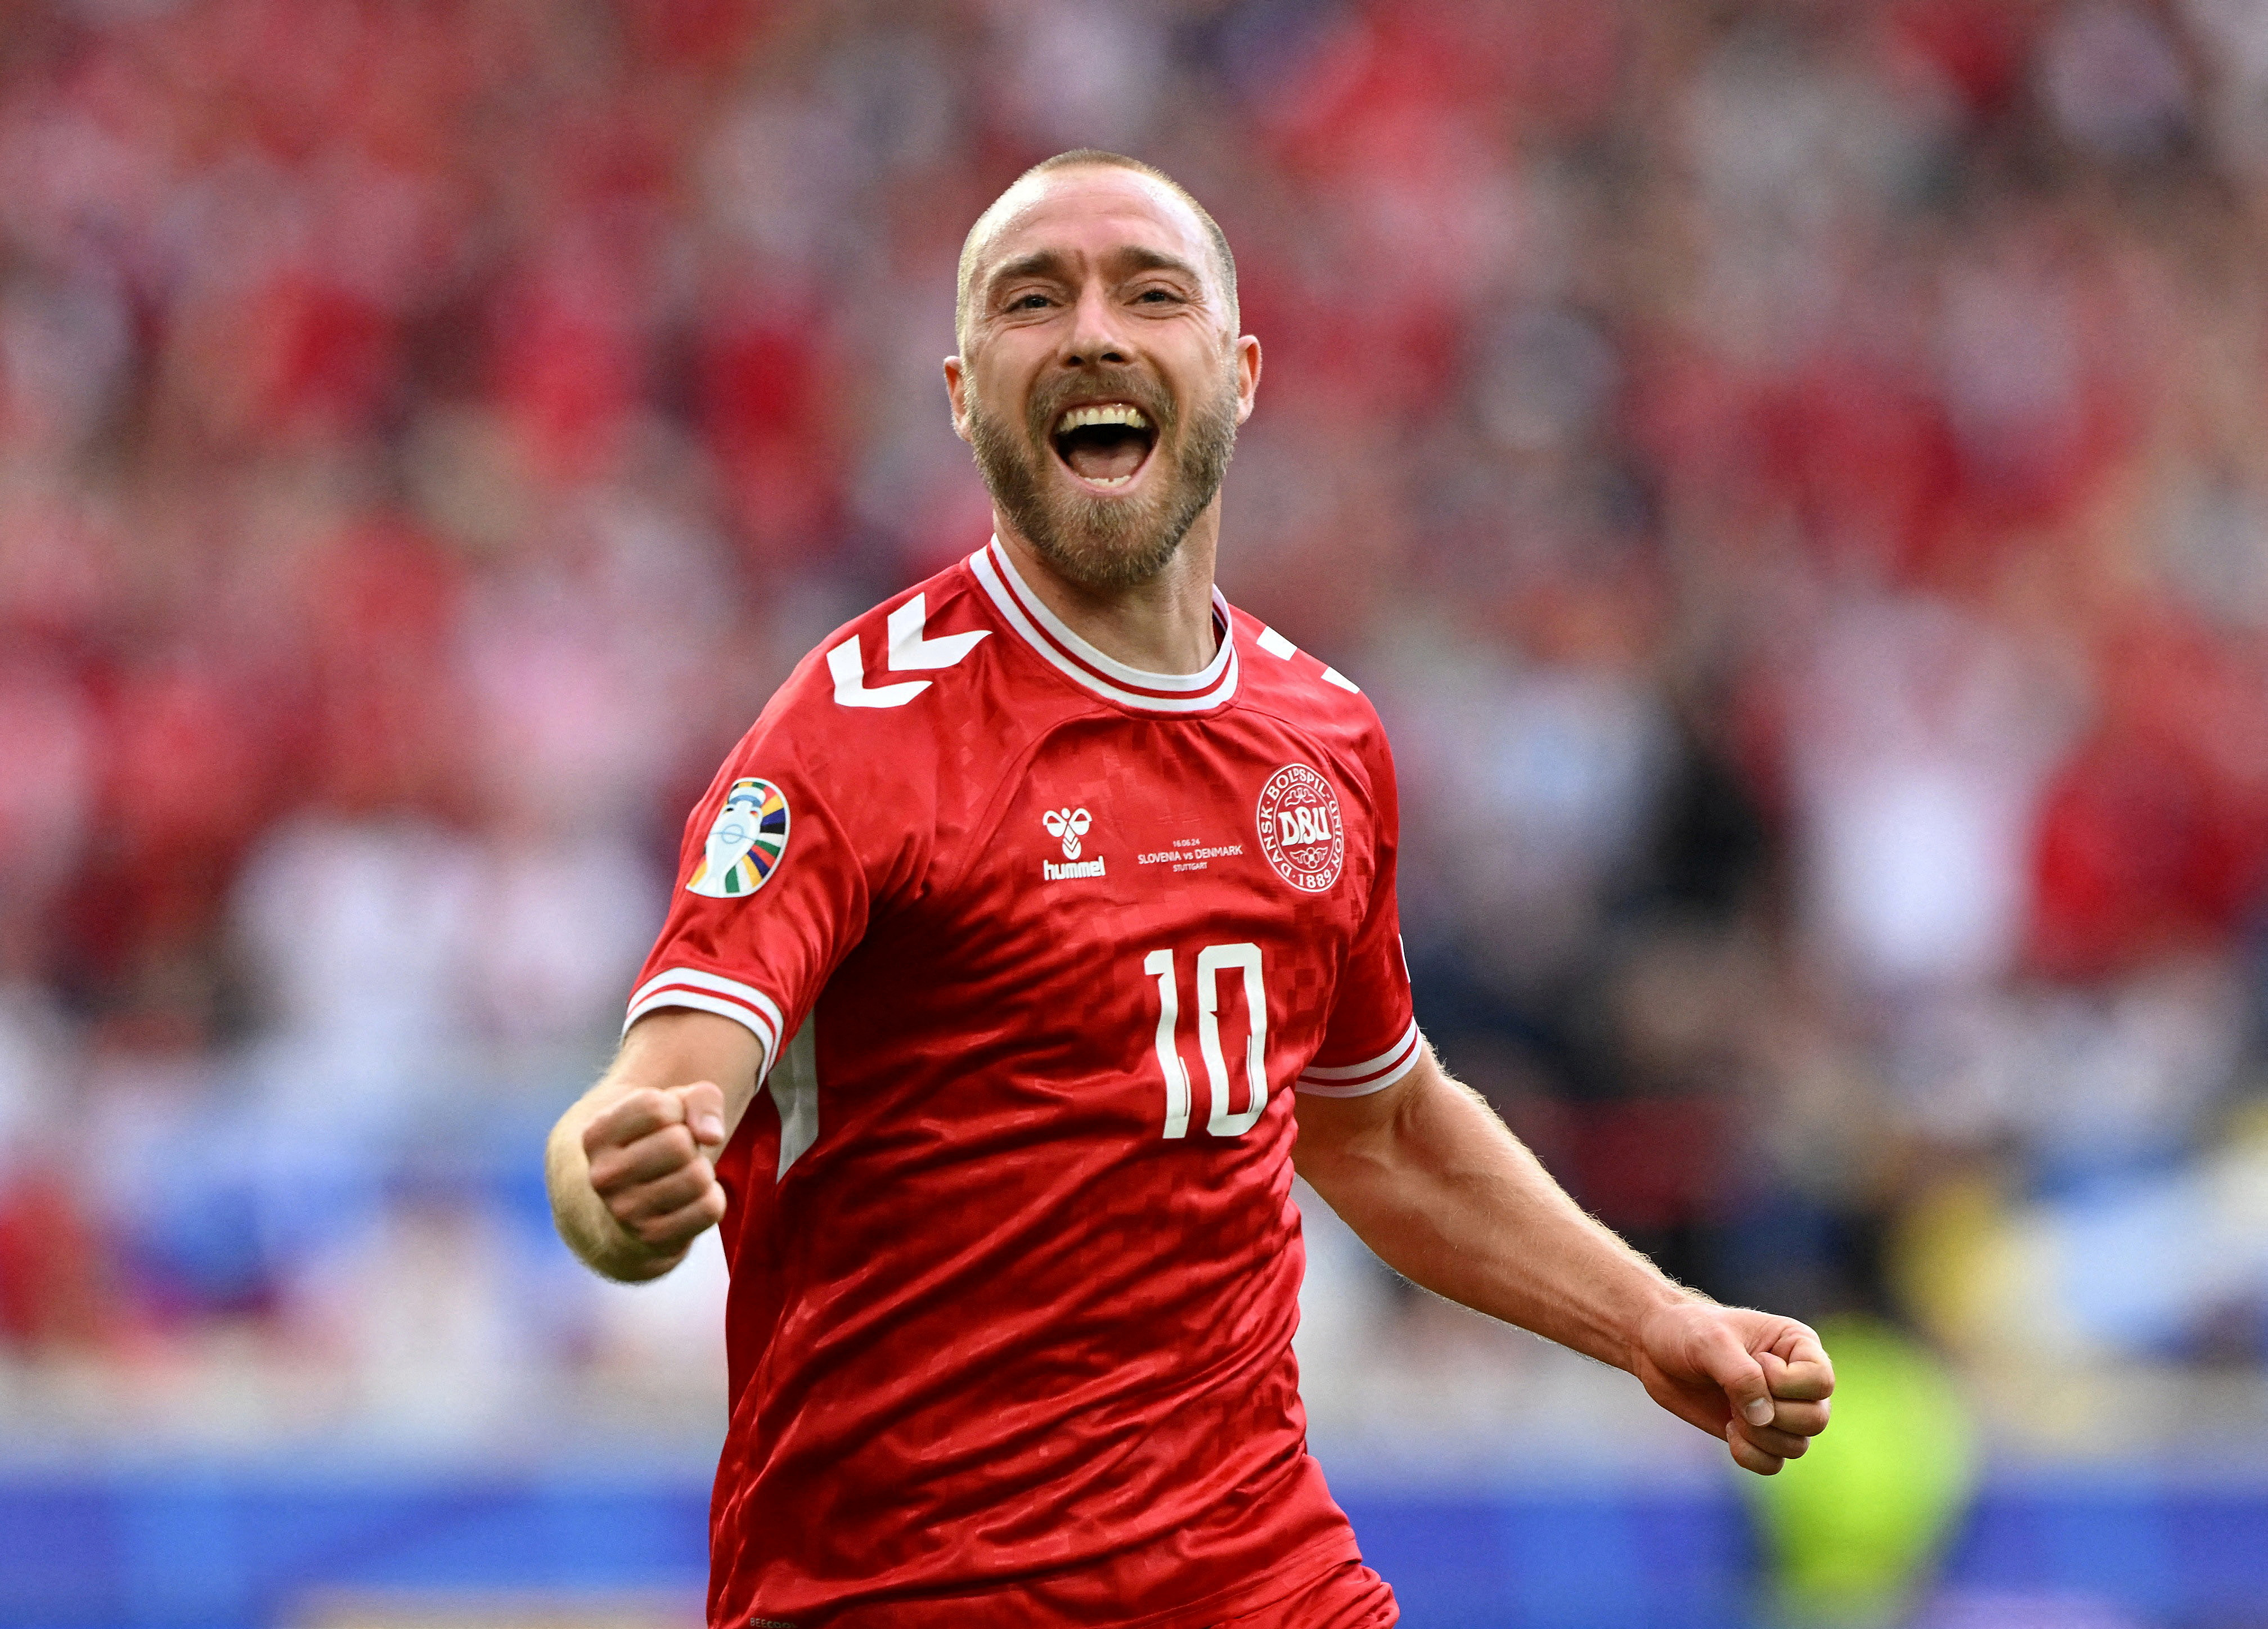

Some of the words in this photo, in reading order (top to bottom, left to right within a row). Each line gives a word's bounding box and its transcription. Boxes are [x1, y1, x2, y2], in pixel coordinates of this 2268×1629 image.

[1278, 806, 1332, 847] DBU
[1137, 851, 1182, 865] SLOVENIA
[1183, 852, 1194, 861] vs
[1194, 845, 1243, 860] DENMARK
[1260, 805, 1292, 878] DANSK
[1298, 868, 1332, 888] 1889
[1043, 855, 1106, 881] hummel
[1173, 862, 1208, 872] STUTTGART
[1144, 943, 1268, 1138] 10
